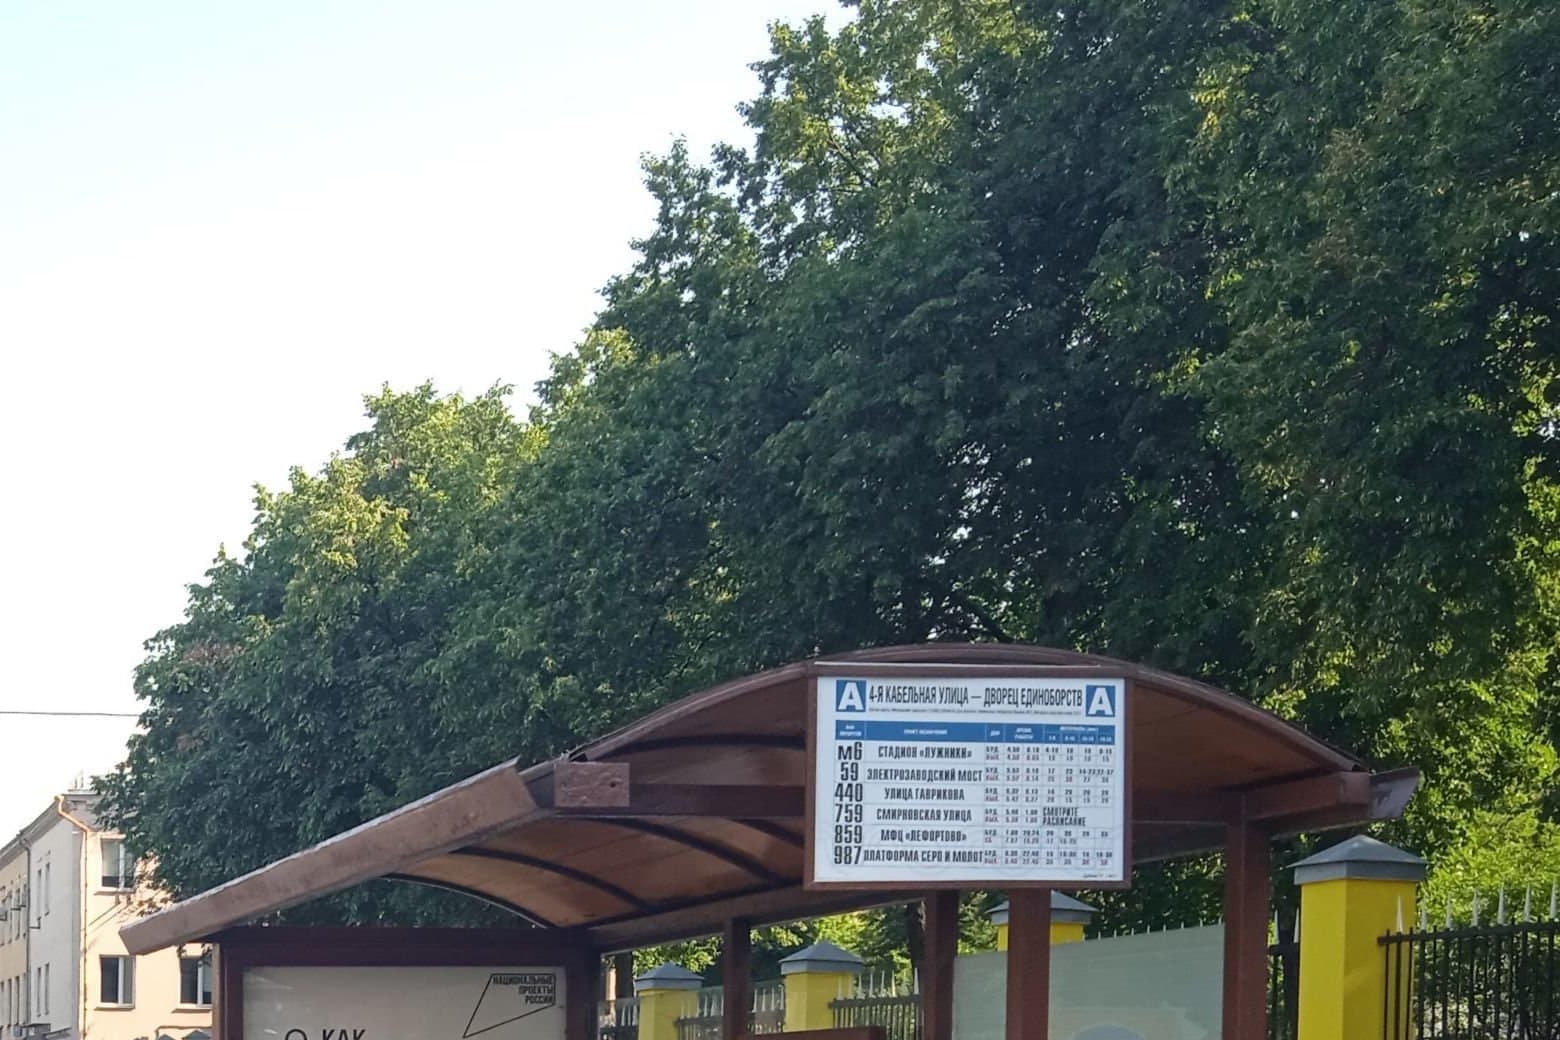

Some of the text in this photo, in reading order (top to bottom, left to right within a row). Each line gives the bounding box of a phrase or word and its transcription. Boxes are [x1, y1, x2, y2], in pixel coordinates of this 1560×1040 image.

[869, 685, 884, 704] 4-Я
[886, 685, 937, 704] КАБЕЛЬНАЯ
[939, 687, 969, 707] УЛИЦА
[984, 687, 1019, 708] ДВОРЕЦ
[1021, 689, 1083, 708] ЕДИНОБОРСТВ
[878, 745, 917, 759] СТАДИОН
[920, 746, 972, 760] «ЛУЖНИКИ»
[840, 761, 859, 781] 59
[867, 768, 955, 782] ЭЛЕКТРОЗАВОДСКИЙ
[958, 769, 983, 781] МОСТ
[835, 783, 863, 802] 440
[884, 787, 965, 801] УЛИЦА ГАВРИКОВА
[835, 803, 863, 823] 759
[877, 808, 941, 821] СМИРНОВСКАЯ
[943, 809, 972, 822] УЛИЦА
[835, 824, 863, 844] 859
[881, 829, 967, 843] МФЦ «ЛЕФОРТОВО»
[834, 845, 862, 865] 987
[864, 849, 919, 862] ПЛАТФОРМА
[921, 851, 942, 862] СЕРП
[944, 851, 951, 862] И
[953, 851, 983, 863] МОЛОТ
